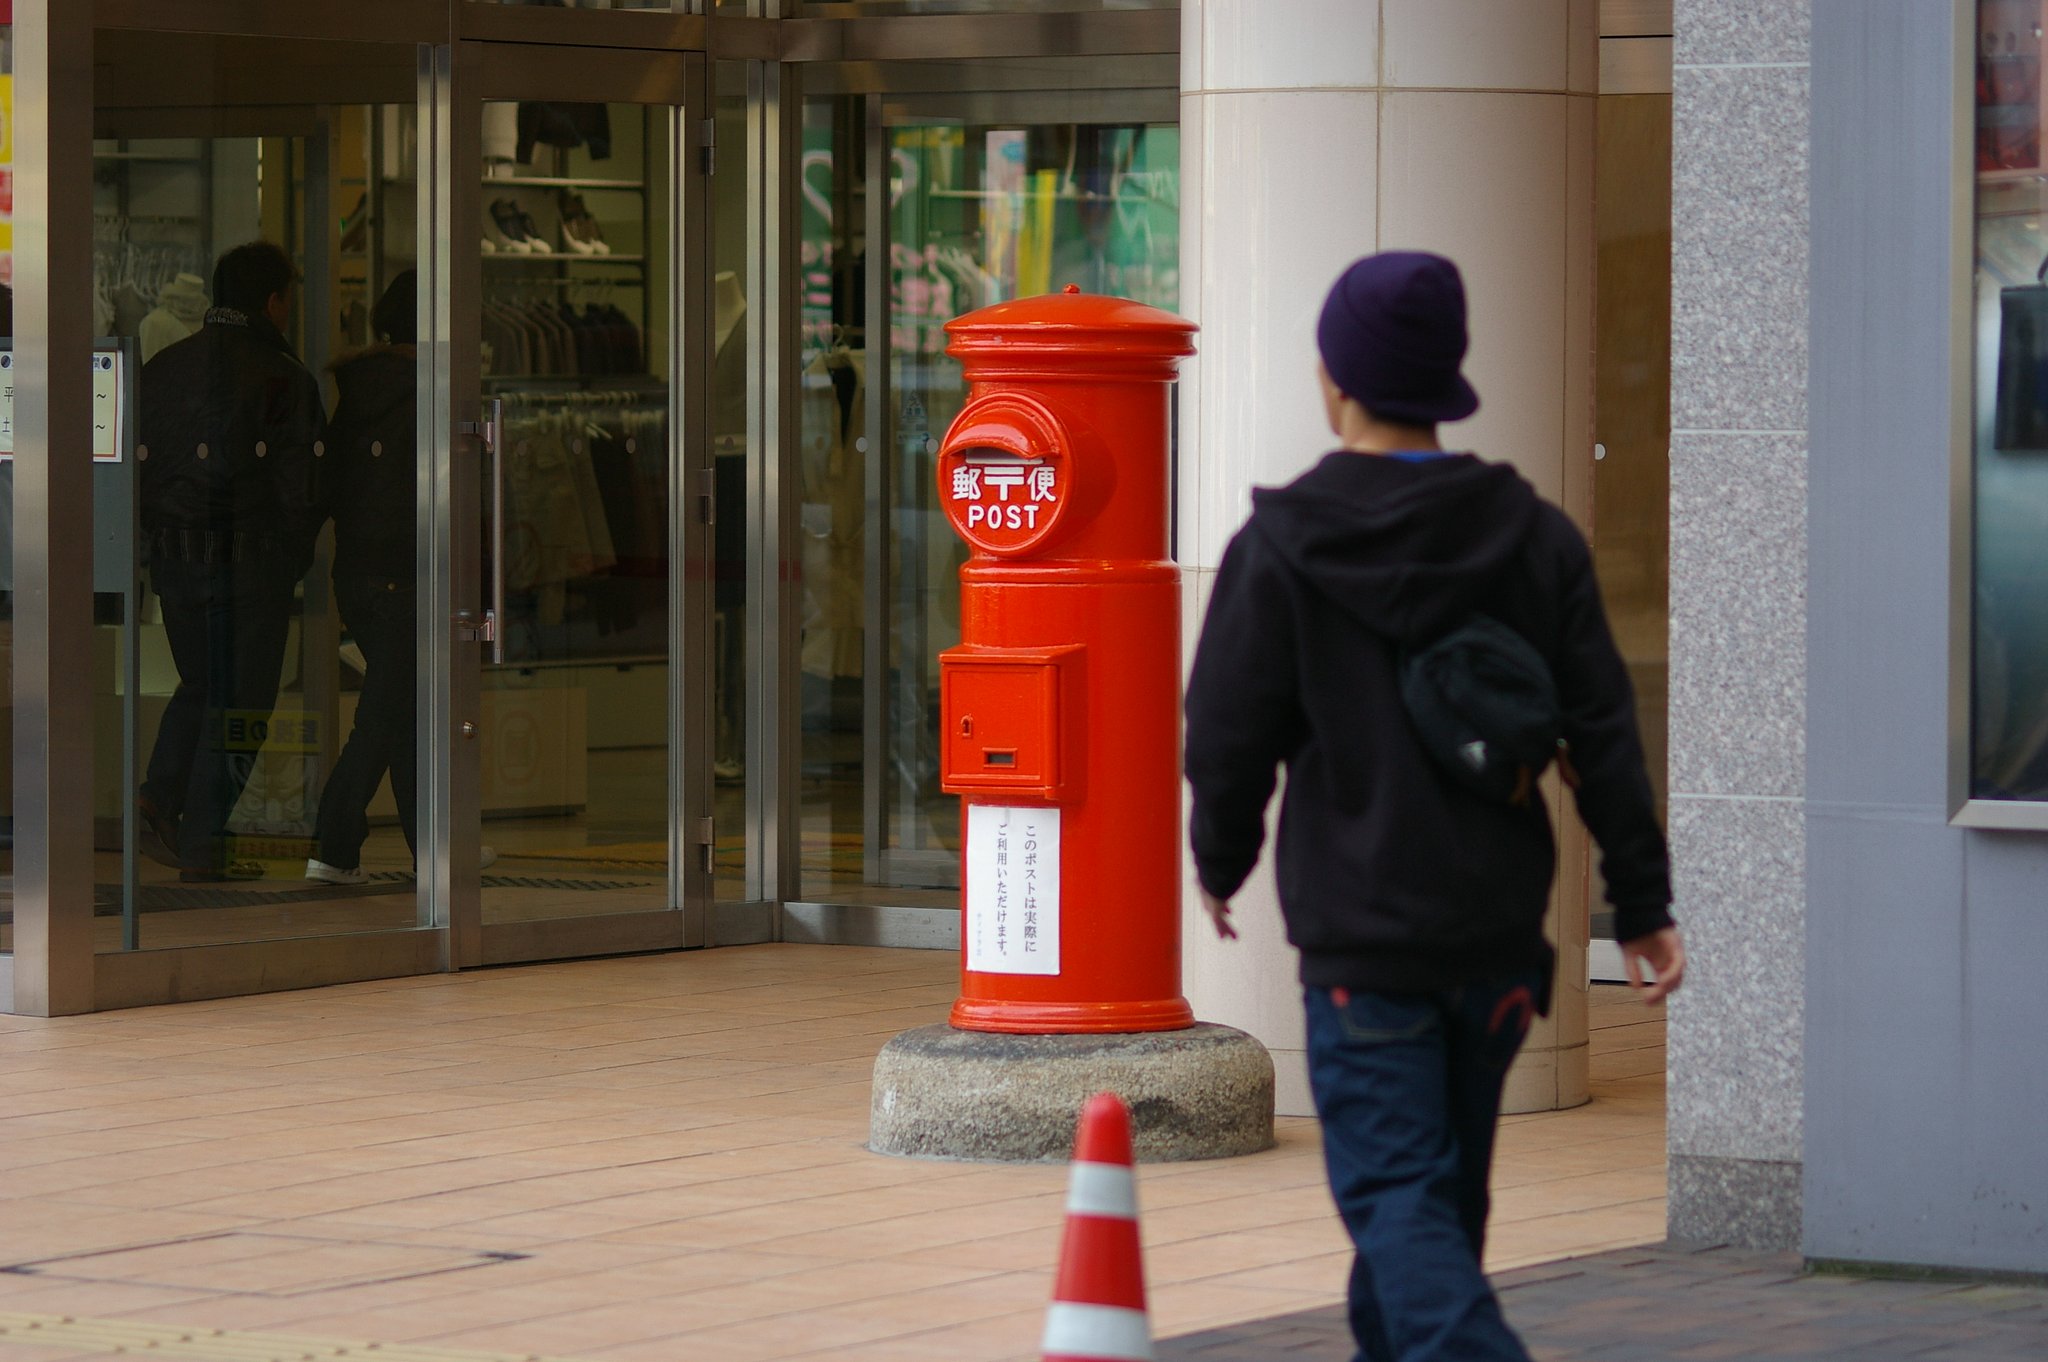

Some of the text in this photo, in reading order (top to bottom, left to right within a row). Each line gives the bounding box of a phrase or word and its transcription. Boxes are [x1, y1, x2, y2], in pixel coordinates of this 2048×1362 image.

[968, 505, 1039, 529] POST
[997, 823, 1009, 956] ご利用いただけます。
[1024, 825, 1037, 953] このポストは実際に
